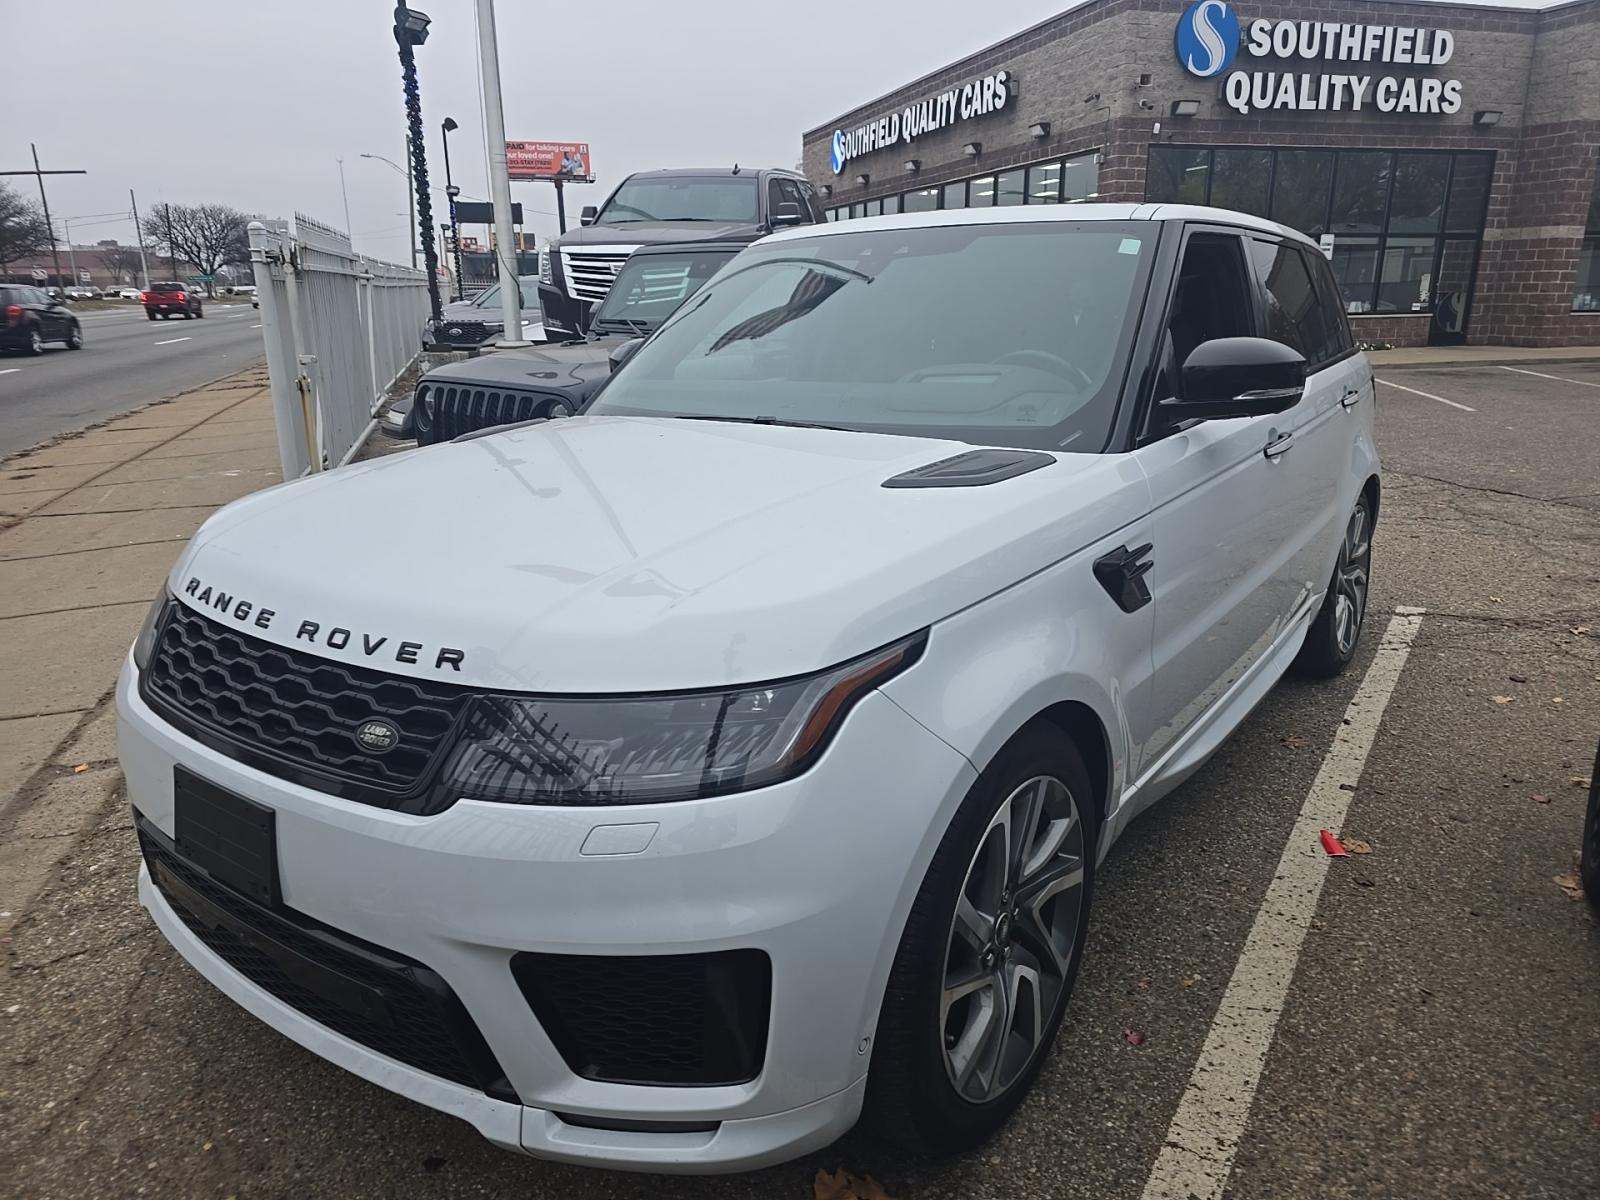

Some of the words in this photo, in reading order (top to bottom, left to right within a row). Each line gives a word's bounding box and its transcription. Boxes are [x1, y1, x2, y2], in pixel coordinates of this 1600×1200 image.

[1247, 18, 1455, 65] SOUTHFIELD
[1225, 70, 1371, 115] QUALITY
[1376, 76, 1464, 115] CARS
[840, 113, 900, 162] SOUTHFIELD
[902, 89, 960, 143] QUALITY
[960, 70, 1007, 120] CARS
[517, 151, 538, 159] loved
[525, 143, 535, 151] for
[536, 144, 559, 153] taking
[184, 576, 276, 629] RANGE
[296, 619, 466, 672] ROVER
